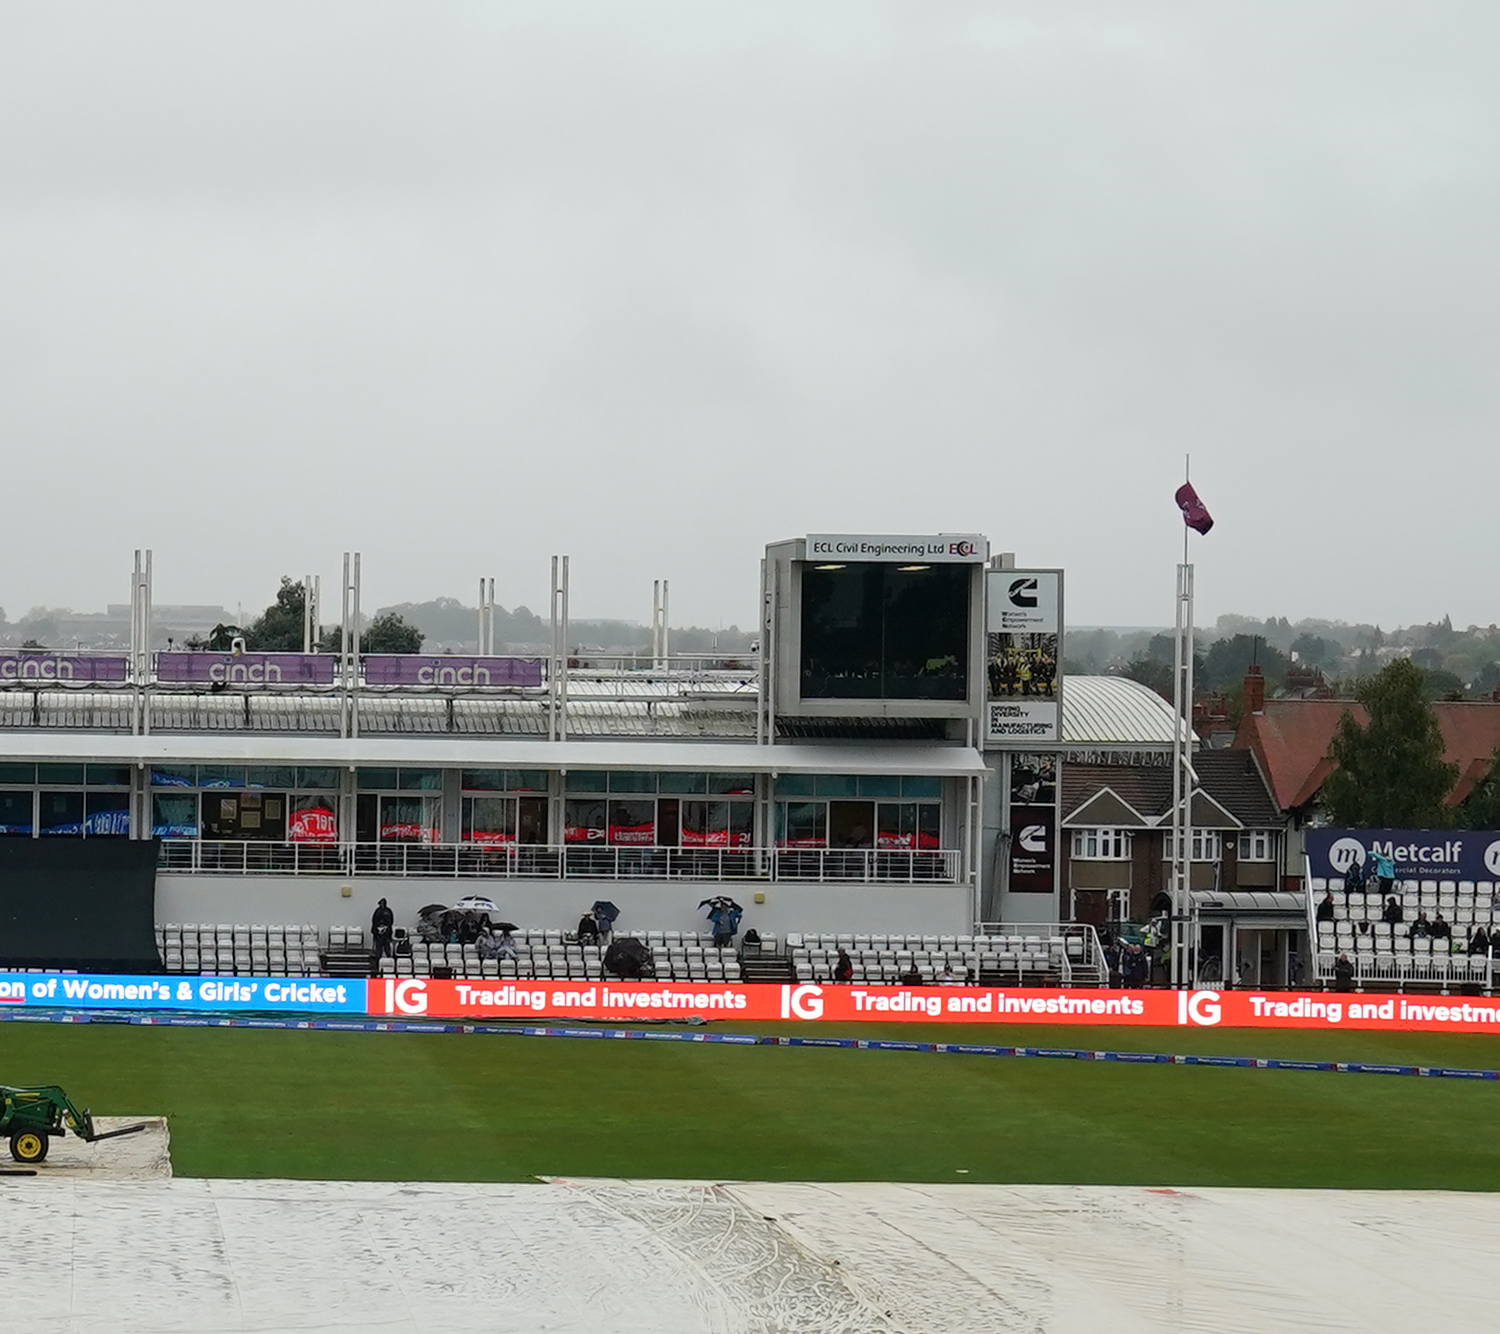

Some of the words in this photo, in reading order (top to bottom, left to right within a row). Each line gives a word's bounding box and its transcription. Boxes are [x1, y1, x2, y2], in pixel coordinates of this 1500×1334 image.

[813, 542, 833, 553] ECL
[836, 542, 859, 553] Civil
[860, 542, 925, 557] Engineering
[927, 544, 945, 554] Ltd
[0, 655, 74, 679] cinch
[208, 656, 282, 683] cinch
[417, 659, 491, 685] cinch
[1372, 841, 1463, 863] Metcalf
[32, 978, 57, 998] of
[62, 979, 171, 1000] Women's
[176, 981, 193, 1001] &
[199, 981, 258, 1002] Girls'
[264, 983, 347, 1004] Cricket
[384, 980, 428, 1013] IG
[455, 985, 546, 1011] Trading
[551, 986, 597, 1007] and
[602, 987, 747, 1009] investments
[780, 986, 824, 1019] IG
[850, 990, 942, 1016] Trading
[947, 992, 992, 1013] and
[998, 992, 1144, 1015] investments
[1177, 991, 1222, 1025] IG
[1249, 996, 1343, 1023] Trading
[1347, 999, 1394, 1020] and
